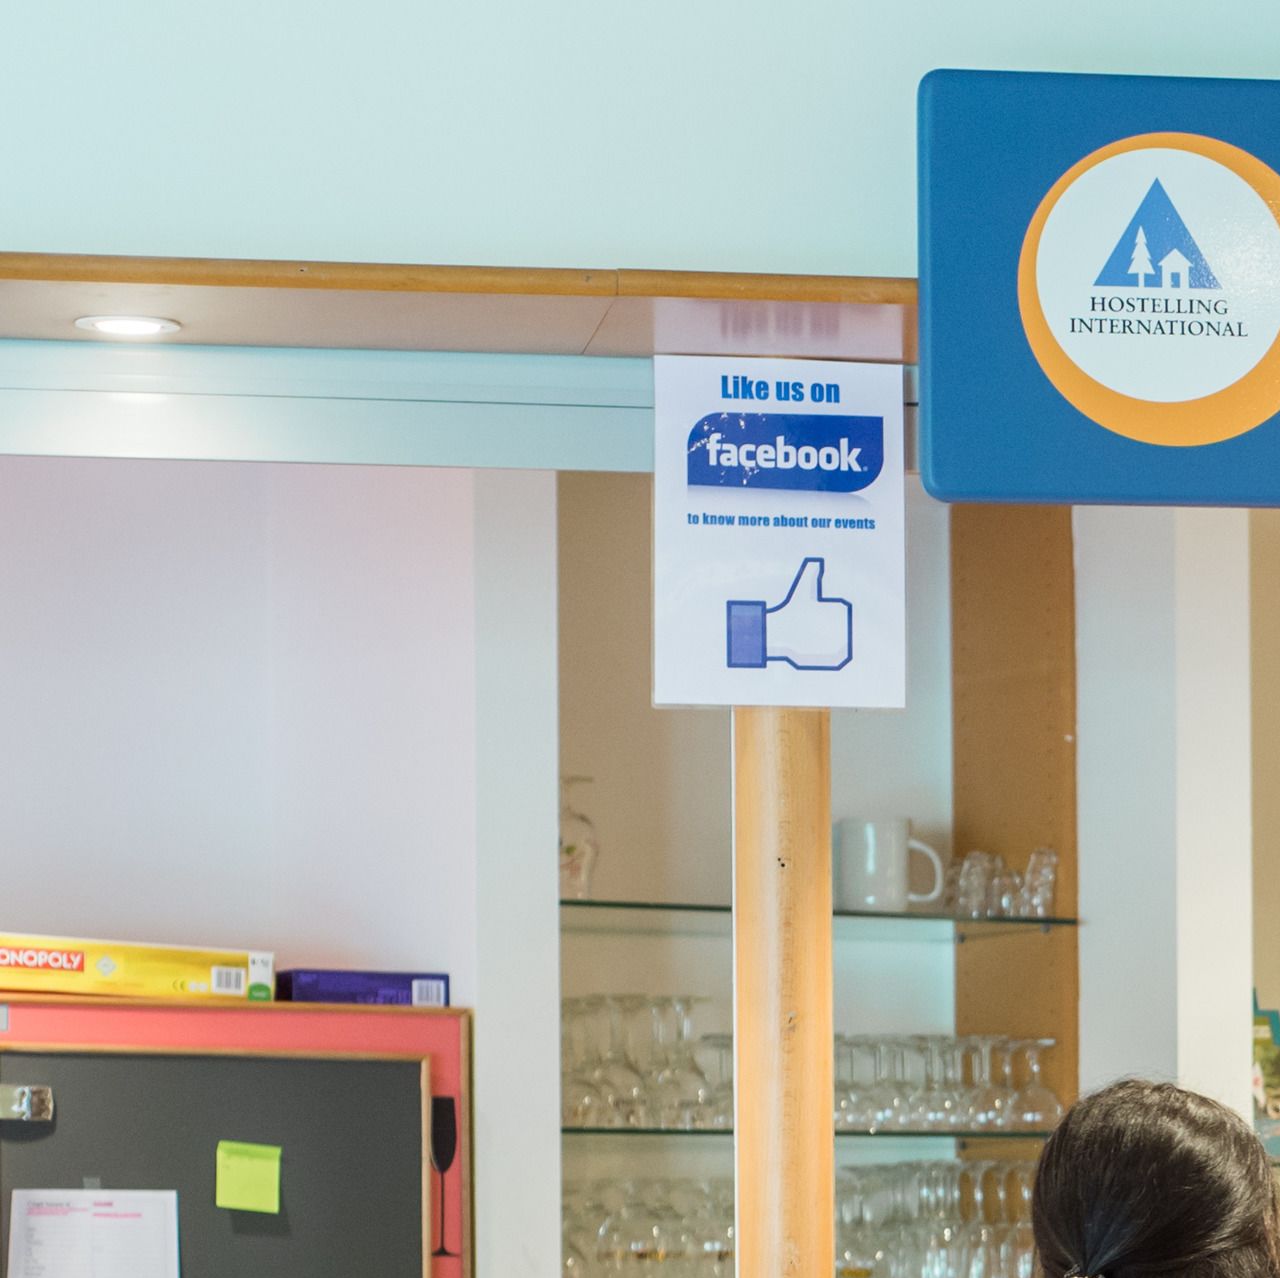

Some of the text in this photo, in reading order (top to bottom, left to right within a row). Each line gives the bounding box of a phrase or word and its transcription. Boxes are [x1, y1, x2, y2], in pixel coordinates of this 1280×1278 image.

[1090, 296, 1228, 315] HOSTELLING
[1070, 318, 1248, 338] INTERNATIONAL
[721, 375, 840, 403] Like us on
[706, 432, 862, 472] facebook
[687, 512, 876, 530] to know more about our events
[0, 948, 81, 970] ONOPOLY
